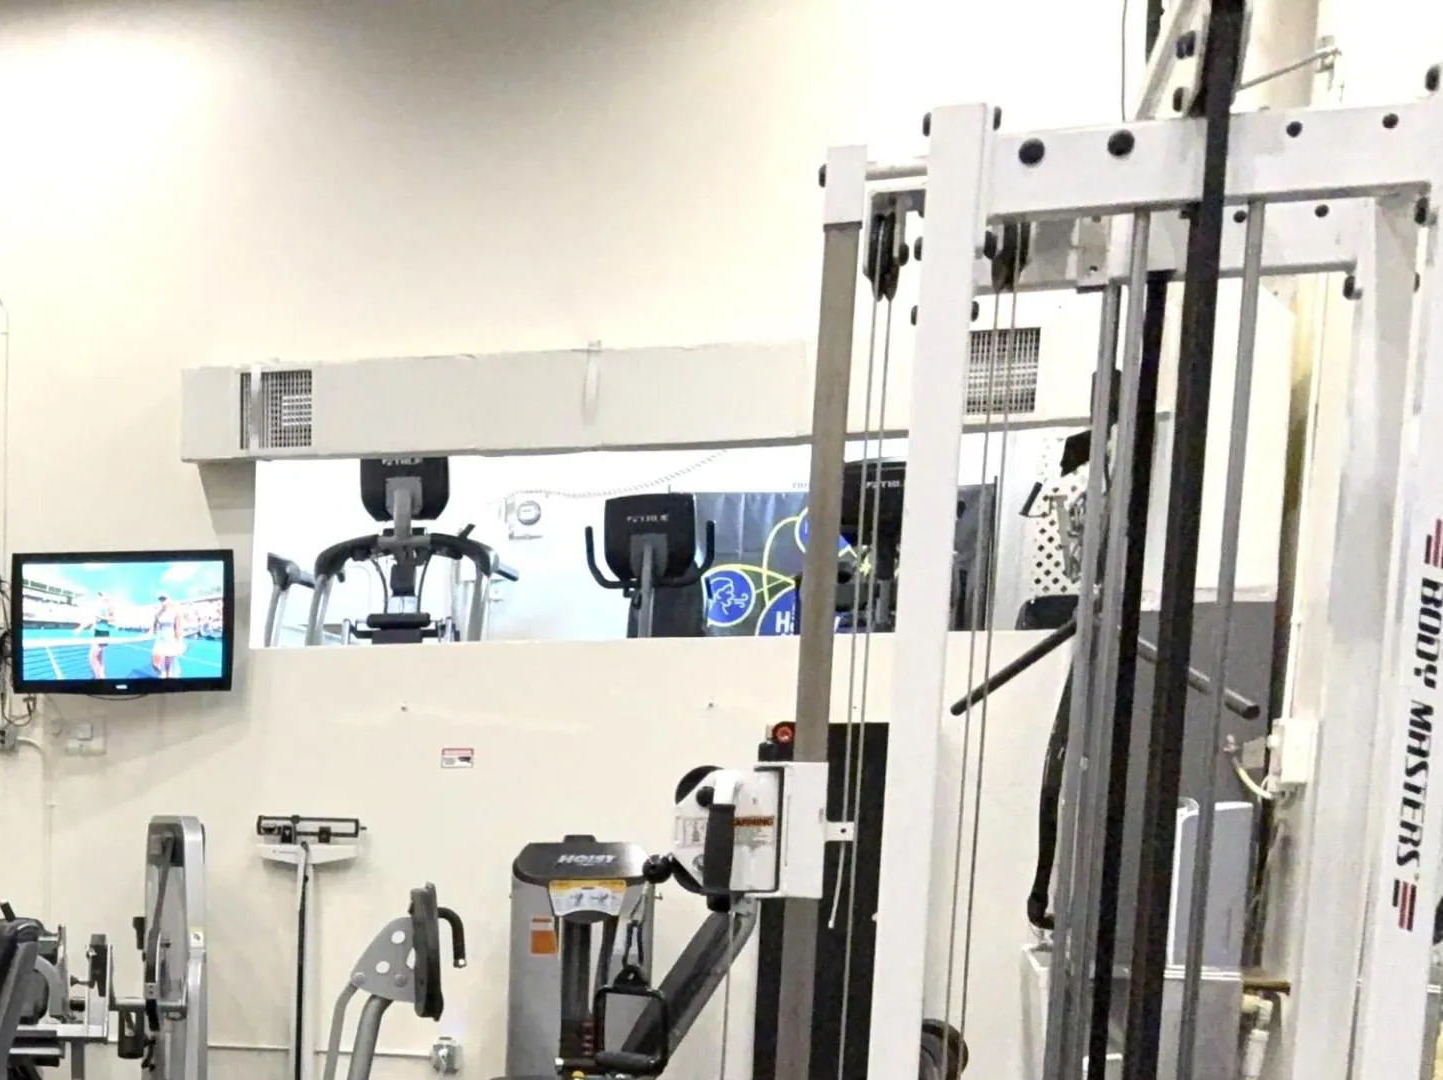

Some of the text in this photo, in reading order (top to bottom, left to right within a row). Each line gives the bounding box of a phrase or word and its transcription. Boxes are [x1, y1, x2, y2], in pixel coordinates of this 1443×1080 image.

[1396, 577, 1443, 869] BODY MASTERS
[734, 815, 774, 827] ARNING
[557, 854, 617, 864] HOIST
